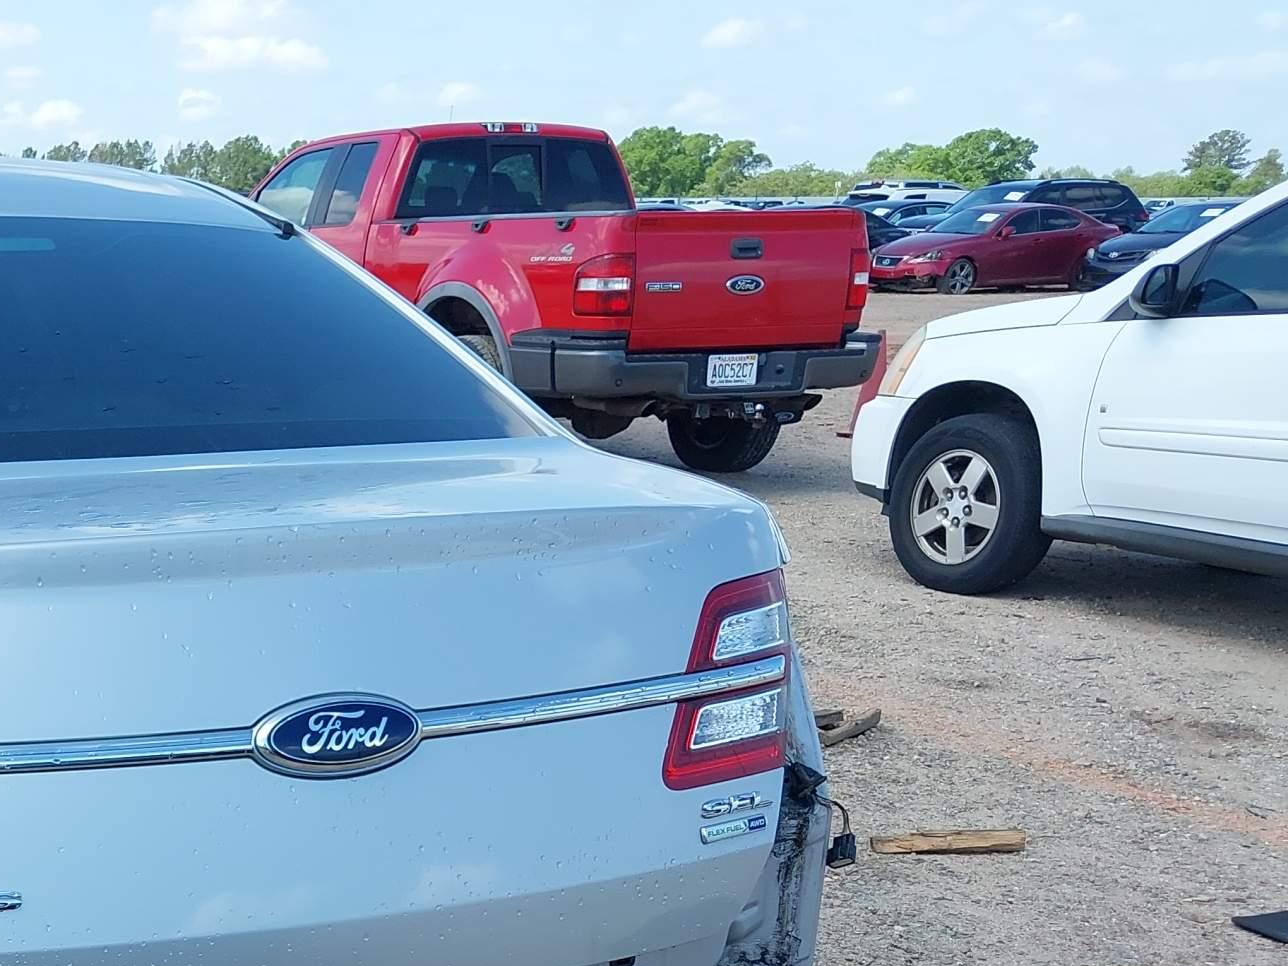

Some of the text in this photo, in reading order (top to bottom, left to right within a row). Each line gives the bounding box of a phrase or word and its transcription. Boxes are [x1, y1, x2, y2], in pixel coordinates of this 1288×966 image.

[301, 709, 389, 754] Ford
[701, 791, 773, 819] SEL
[707, 819, 765, 838] FLEX FUEL AWD
